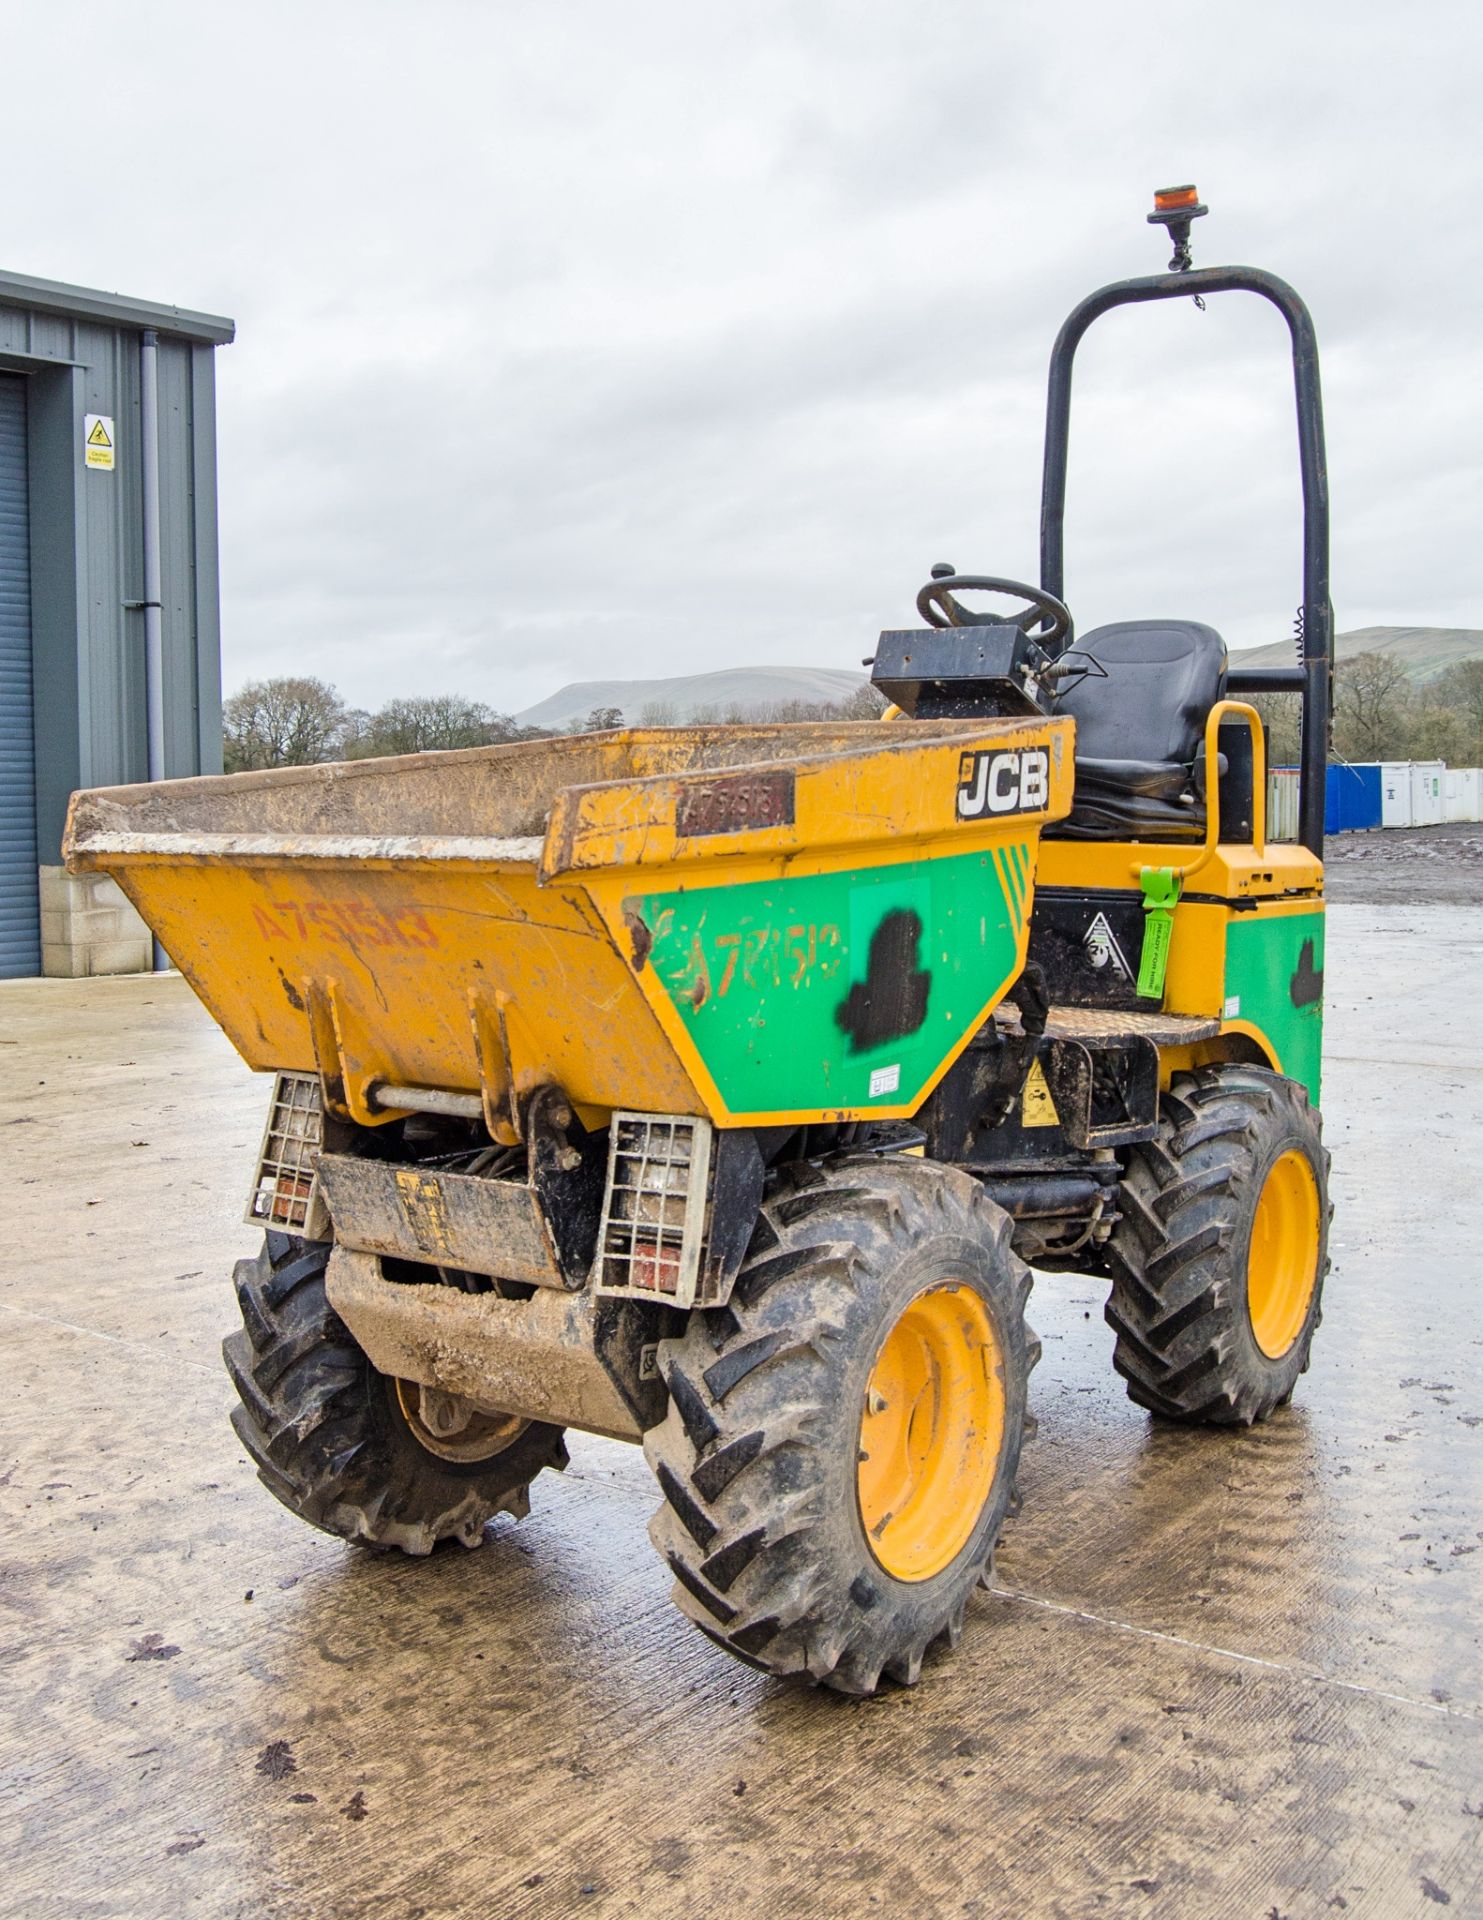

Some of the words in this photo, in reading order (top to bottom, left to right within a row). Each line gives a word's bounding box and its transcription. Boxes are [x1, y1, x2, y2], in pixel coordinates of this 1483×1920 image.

[958, 752, 1048, 815] JCB
[1154, 923, 1163, 950] READY
[1148, 971, 1156, 991] HIRE
